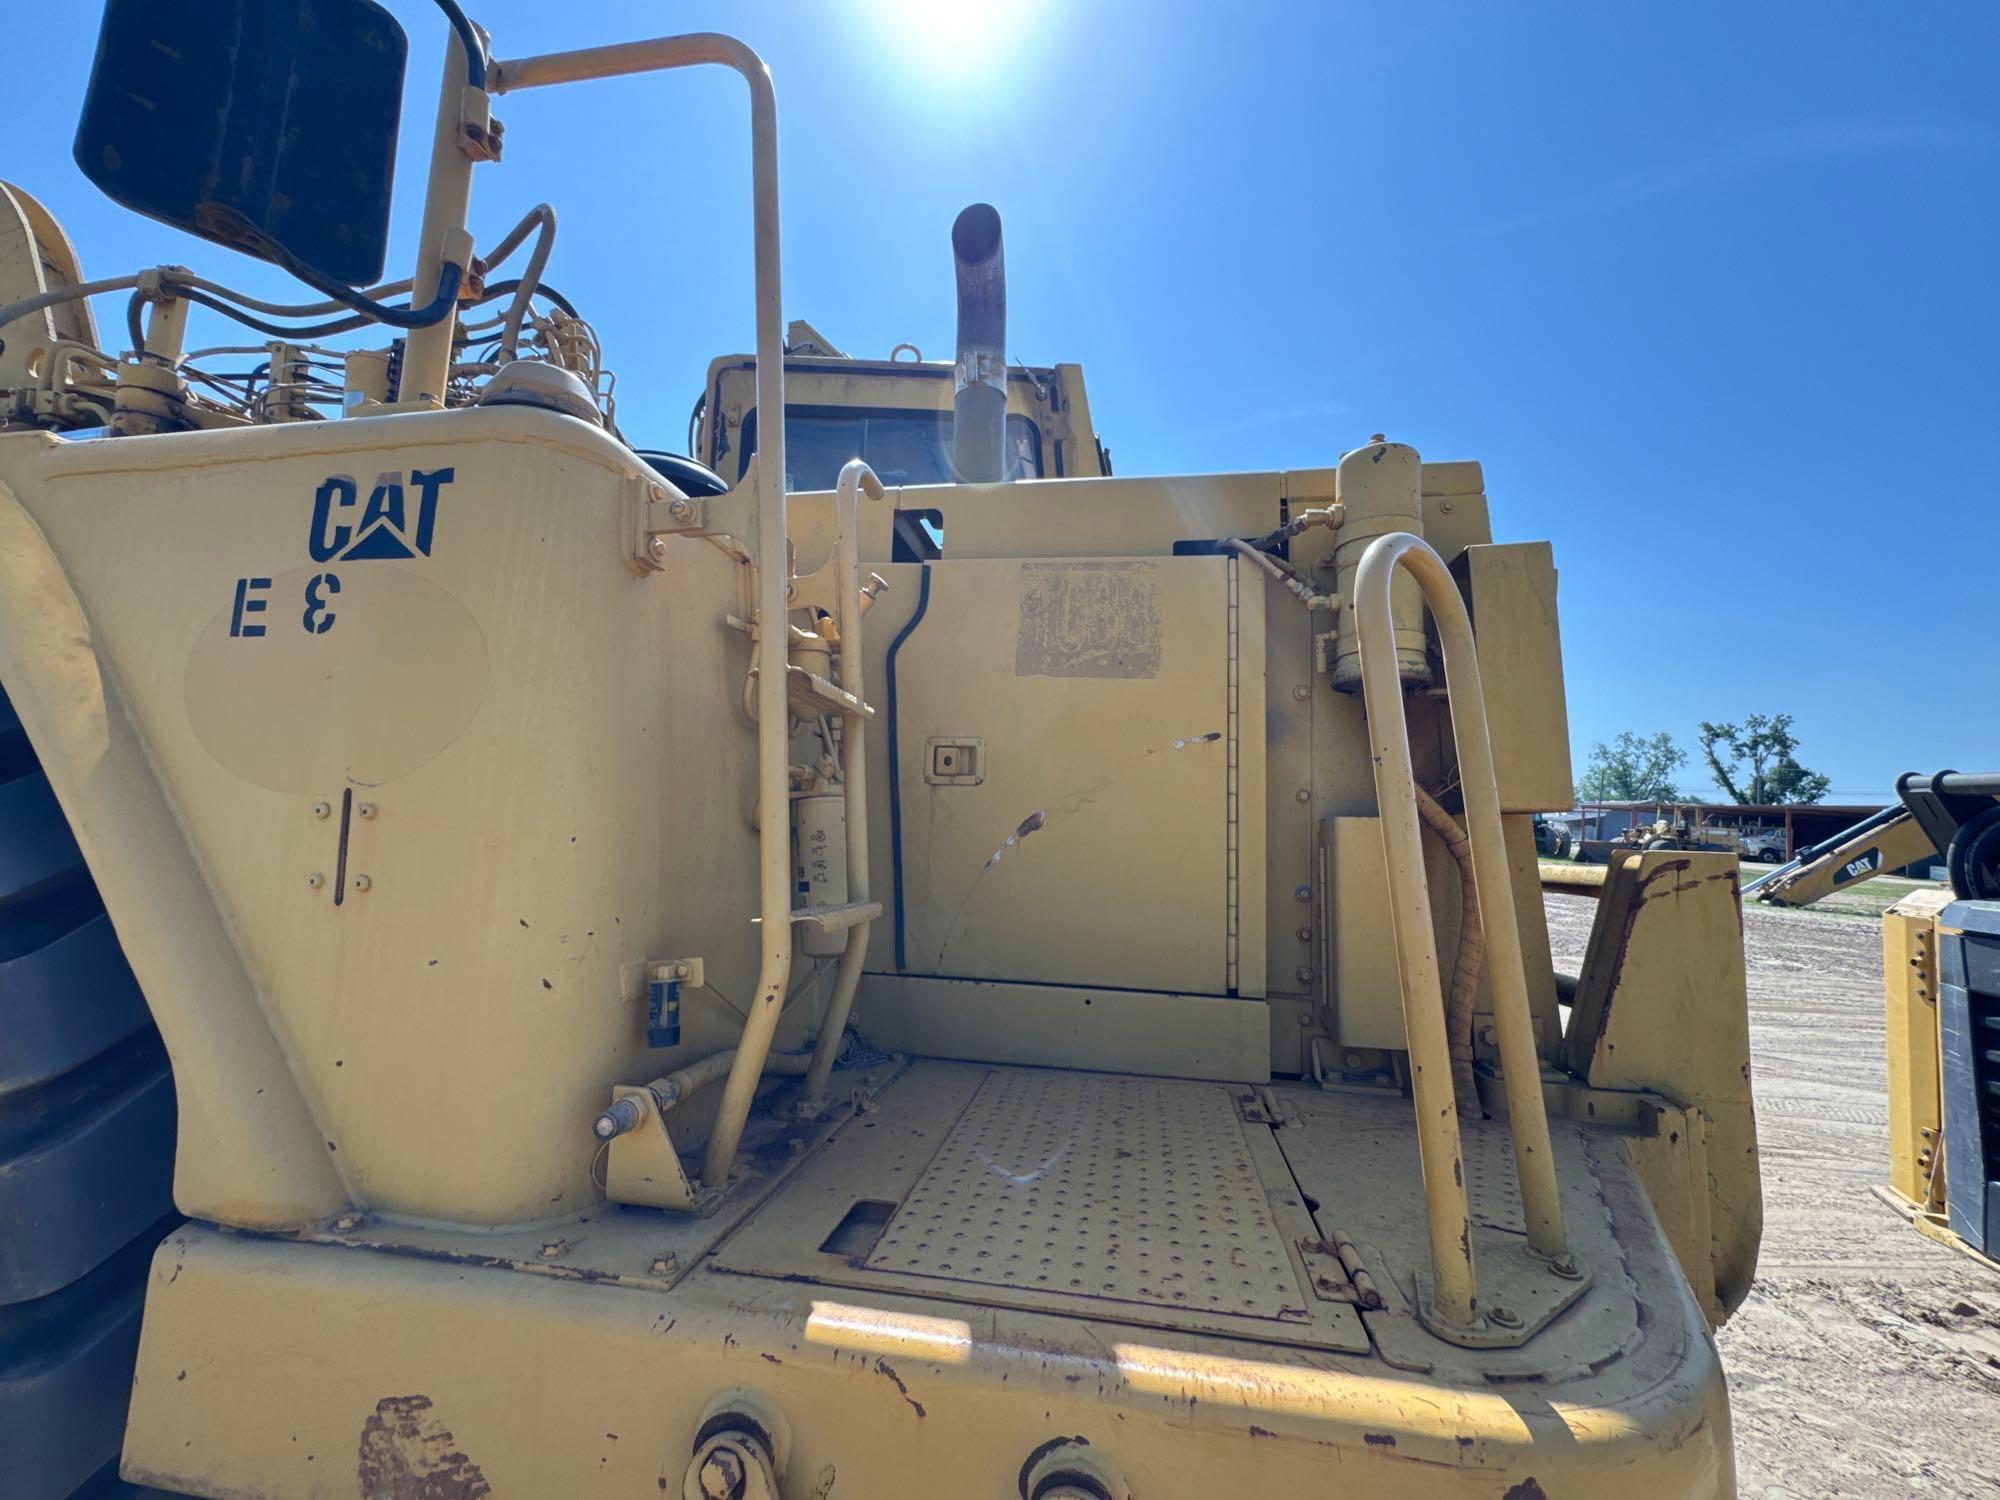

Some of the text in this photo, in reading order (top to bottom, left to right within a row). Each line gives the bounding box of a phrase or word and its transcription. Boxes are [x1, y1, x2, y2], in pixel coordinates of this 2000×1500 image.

[309, 467, 454, 563] CAT
[229, 577, 272, 637] E
[1846, 857, 1873, 877] CAT
